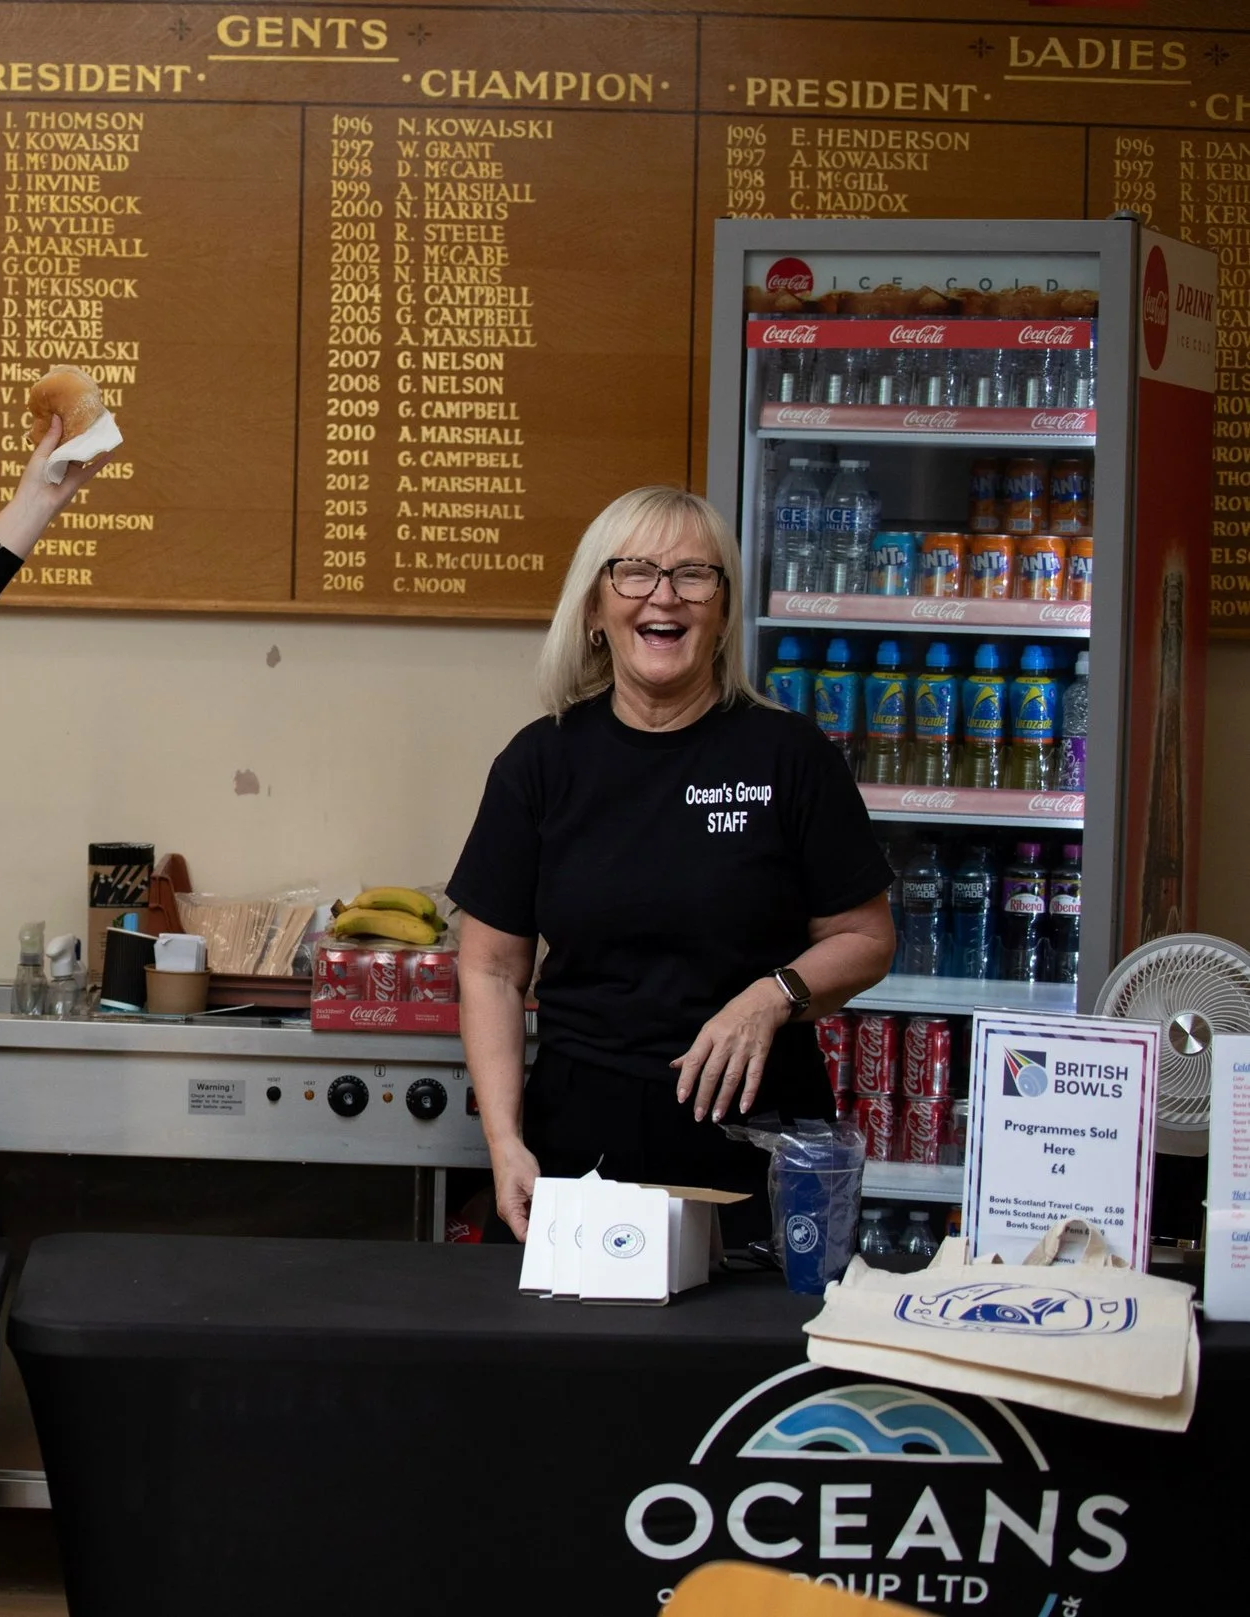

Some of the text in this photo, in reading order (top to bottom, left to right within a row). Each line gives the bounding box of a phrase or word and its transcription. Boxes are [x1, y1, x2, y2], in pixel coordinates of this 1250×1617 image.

[216, 15, 389, 51] GENTS
[1009, 36, 1187, 72] LADIES
[26, 112, 145, 130] THOMSON
[332, 113, 373, 136] 1996
[425, 118, 554, 139] KOWALSKI
[26, 133, 140, 152] KOWALSKI
[726, 123, 767, 146] 1996
[816, 128, 971, 152] HENDERSON
[331, 139, 373, 158] 1997
[425, 141, 496, 159] GRANT
[726, 147, 766, 168] 1997
[816, 150, 929, 171] KOWALSKI
[331, 159, 372, 177] 1998
[425, 160, 505, 180] McCABE
[726, 168, 766, 189] 1998
[816, 171, 890, 193] McGILL
[331, 180, 371, 199] 1999
[424, 181, 537, 203] MARSHALL
[331, 201, 382, 219] 2000
[424, 202, 509, 220] HARRIS
[726, 190, 766, 210] 1999
[816, 192, 910, 214] MADDOX
[26, 217, 115, 235] WYLLIE
[330, 222, 376, 241] 2001
[424, 224, 506, 243] STEELE
[330, 244, 381, 263] 2002
[423, 245, 510, 267] McCABE
[330, 284, 382, 304] 2004
[424, 285, 534, 307] CAMPBELL
[1176, 283, 1214, 321] DRINK
[25, 340, 140, 361] KOWALSKI
[327, 350, 381, 369] 2007
[422, 352, 504, 371] NELSON
[327, 399, 380, 417] 2009
[421, 401, 520, 421] CAMPBELL
[326, 424, 376, 442] 2010
[421, 426, 525, 446] MARSHALL
[326, 449, 370, 466] 2011
[420, 451, 523, 469] CAMPBELL
[326, 474, 370, 491] 2012
[421, 476, 527, 494] MARSHALL
[61, 513, 154, 531] THOMSON
[777, 509, 801, 523] ICE
[826, 509, 851, 523] ICE
[325, 523, 368, 540] 2014
[421, 526, 500, 544] NELSON
[41, 568, 92, 585] KERR
[323, 574, 364, 592] 2016
[413, 578, 467, 594] NOON
[686, 782, 772, 806] Ocean's Group
[707, 811, 748, 833] STAFF
[1010, 900, 1042, 912] Ribena
[1055, 1061, 1128, 1081] BRITISH
[197, 1083, 230, 1093] Warning
[1054, 1079, 1123, 1098] BOWLS
[1004, 1120, 1118, 1140] Programmes Sold
[1043, 1143, 1076, 1156] Here
[1051, 1163, 1066, 1175] £4
[989, 1207, 1011, 1216] Bowls
[1013, 1210, 1045, 1219] Scotland
[990, 1195, 1124, 1214] Bowls Scotland Travel Cups £5.00
[1006, 1221, 1028, 1230] Bowls
[625, 1480, 1131, 1574] OCEANS
[917, 1573, 989, 1604] LTD
